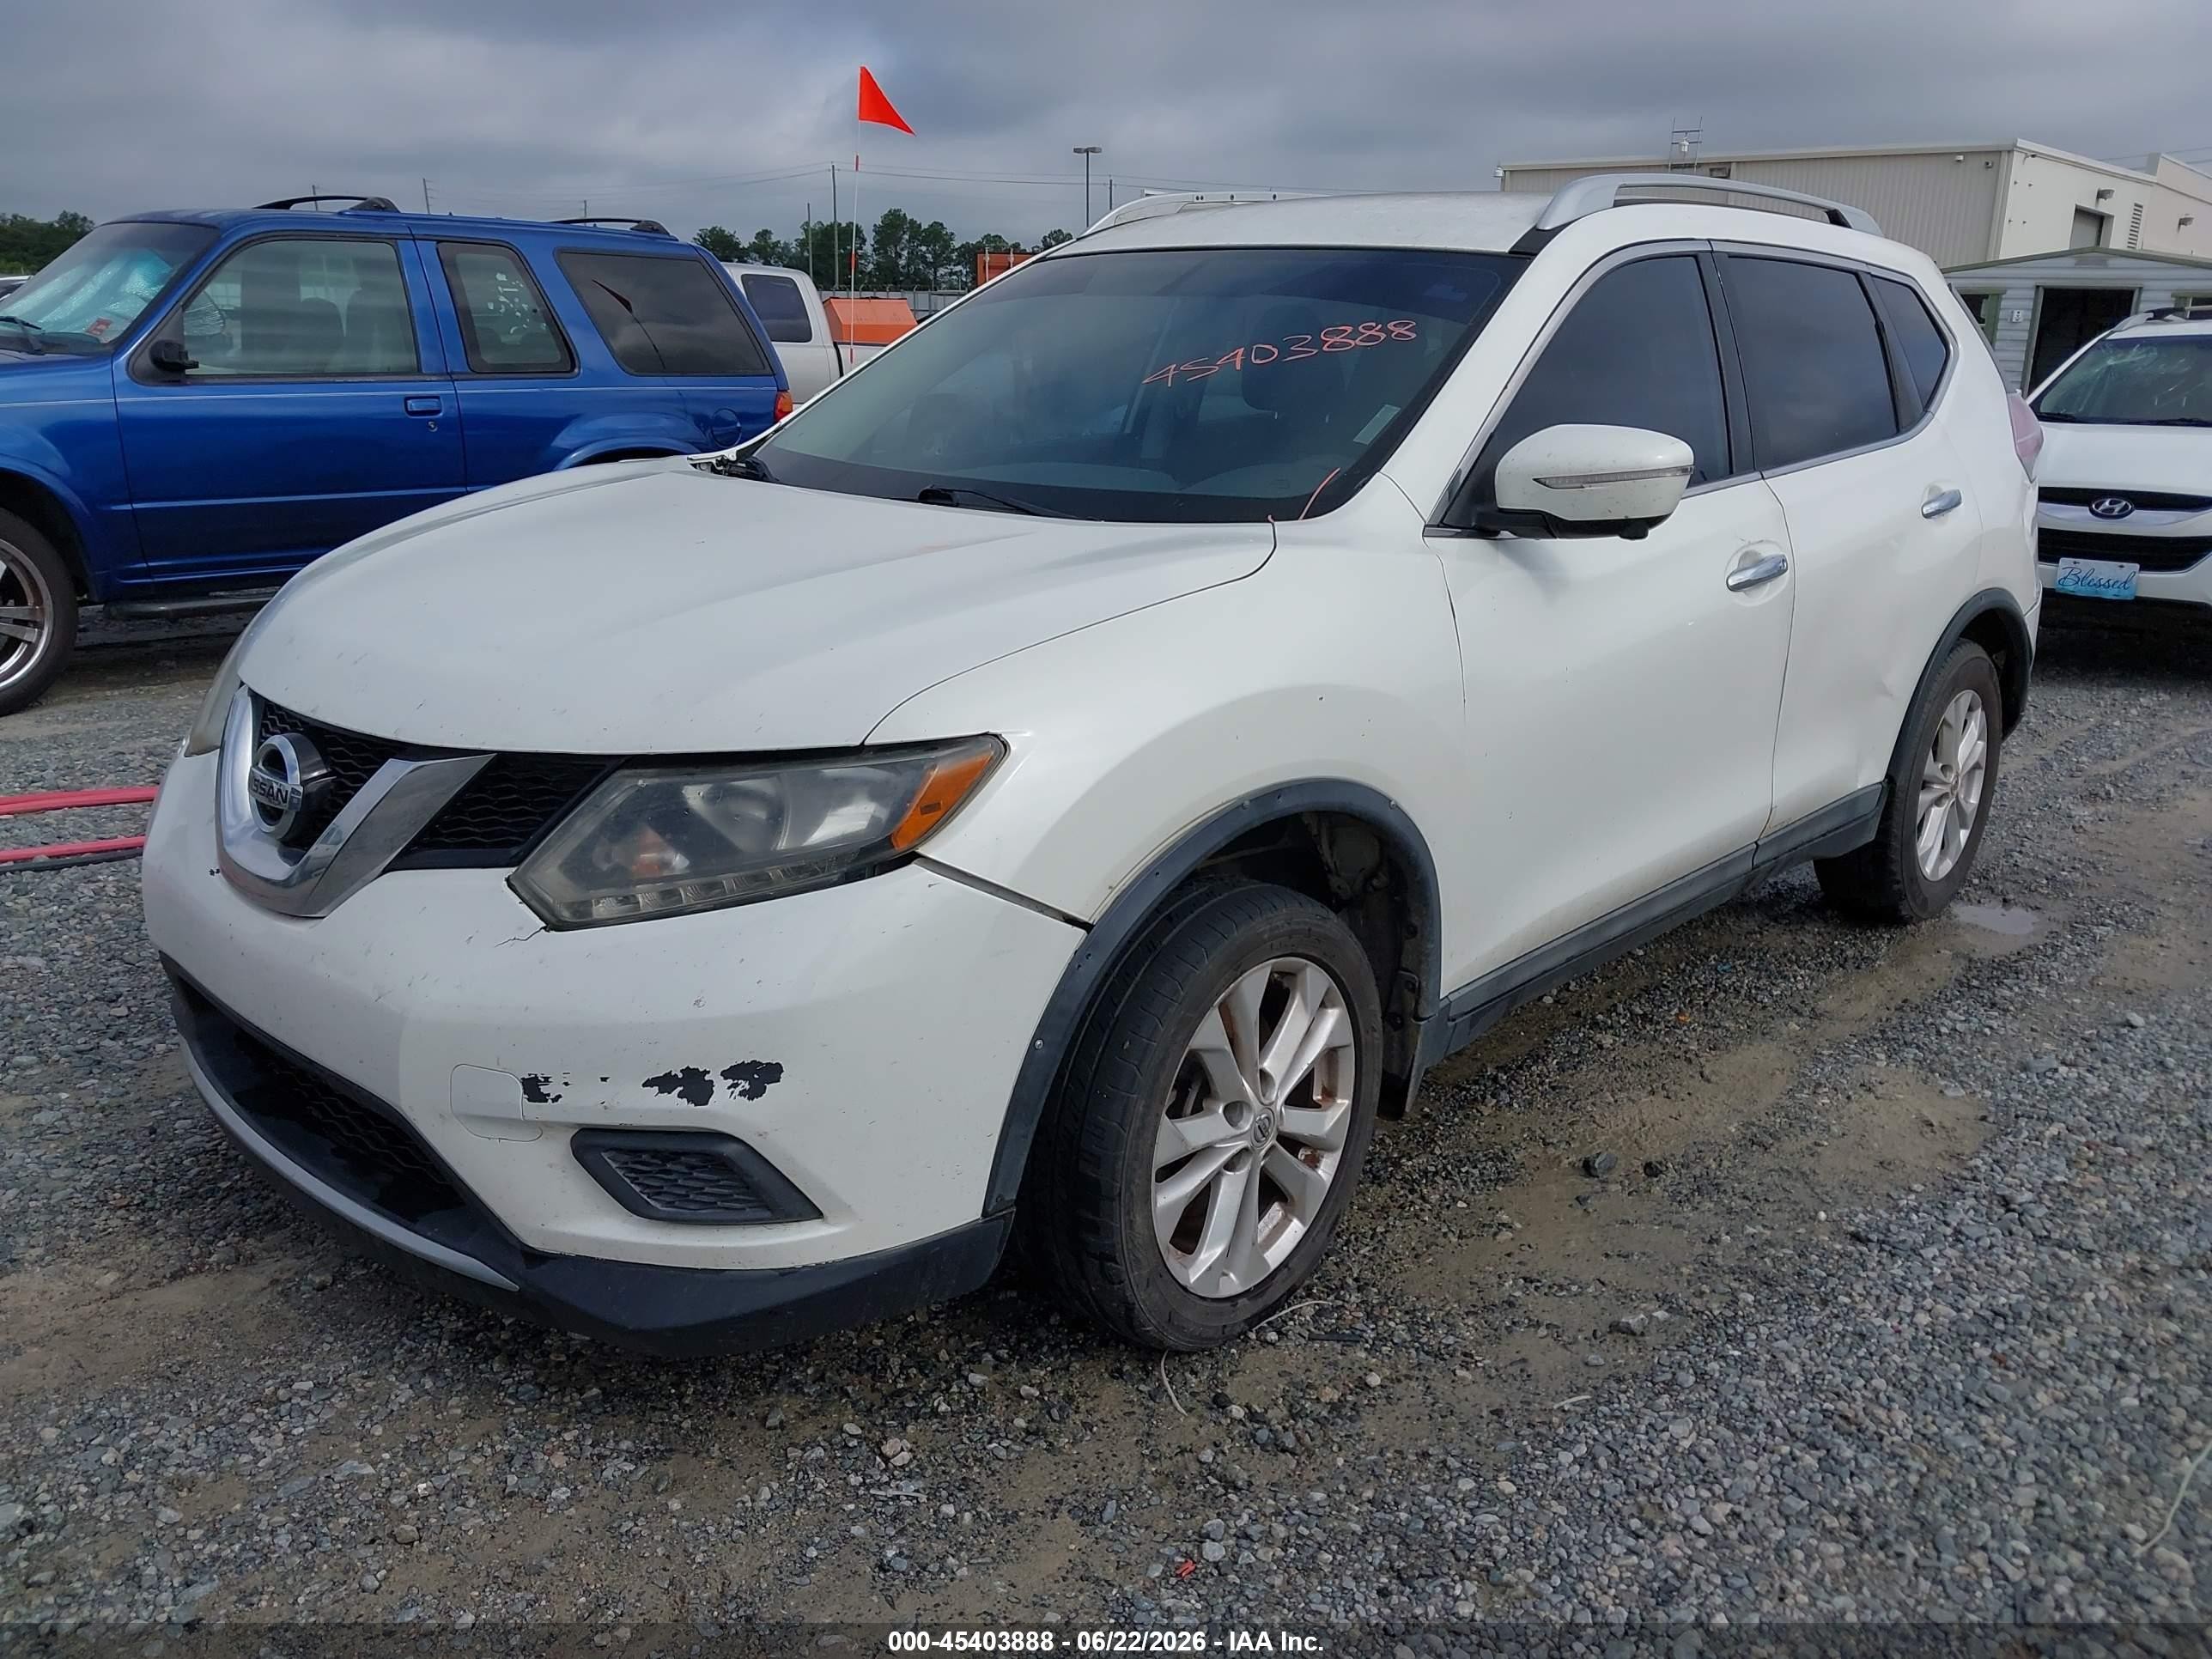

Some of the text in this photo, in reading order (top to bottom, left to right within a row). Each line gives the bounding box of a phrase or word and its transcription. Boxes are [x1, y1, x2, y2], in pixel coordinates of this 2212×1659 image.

[1141, 319, 1417, 387] 45403888
[2058, 566, 2136, 591] Blessed
[251, 775, 289, 804] SSAN
